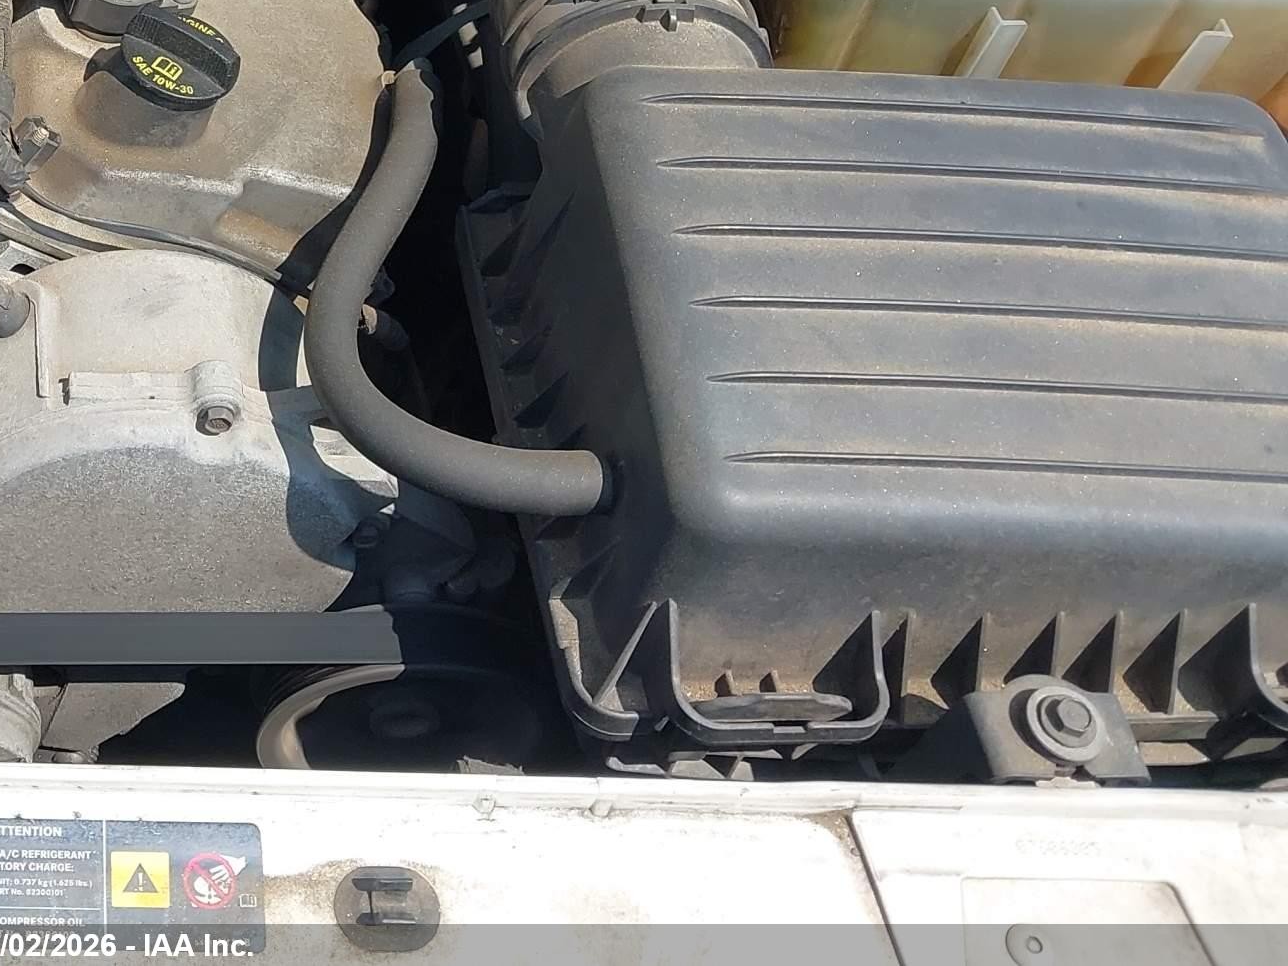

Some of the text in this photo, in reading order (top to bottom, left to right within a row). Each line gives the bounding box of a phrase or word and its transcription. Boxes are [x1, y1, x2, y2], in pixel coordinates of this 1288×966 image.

[132, 55, 194, 95] SAE 10W-30
[21, 850, 92, 860] REFRIGERANT
[28, 862, 74, 873] CHARGE:
